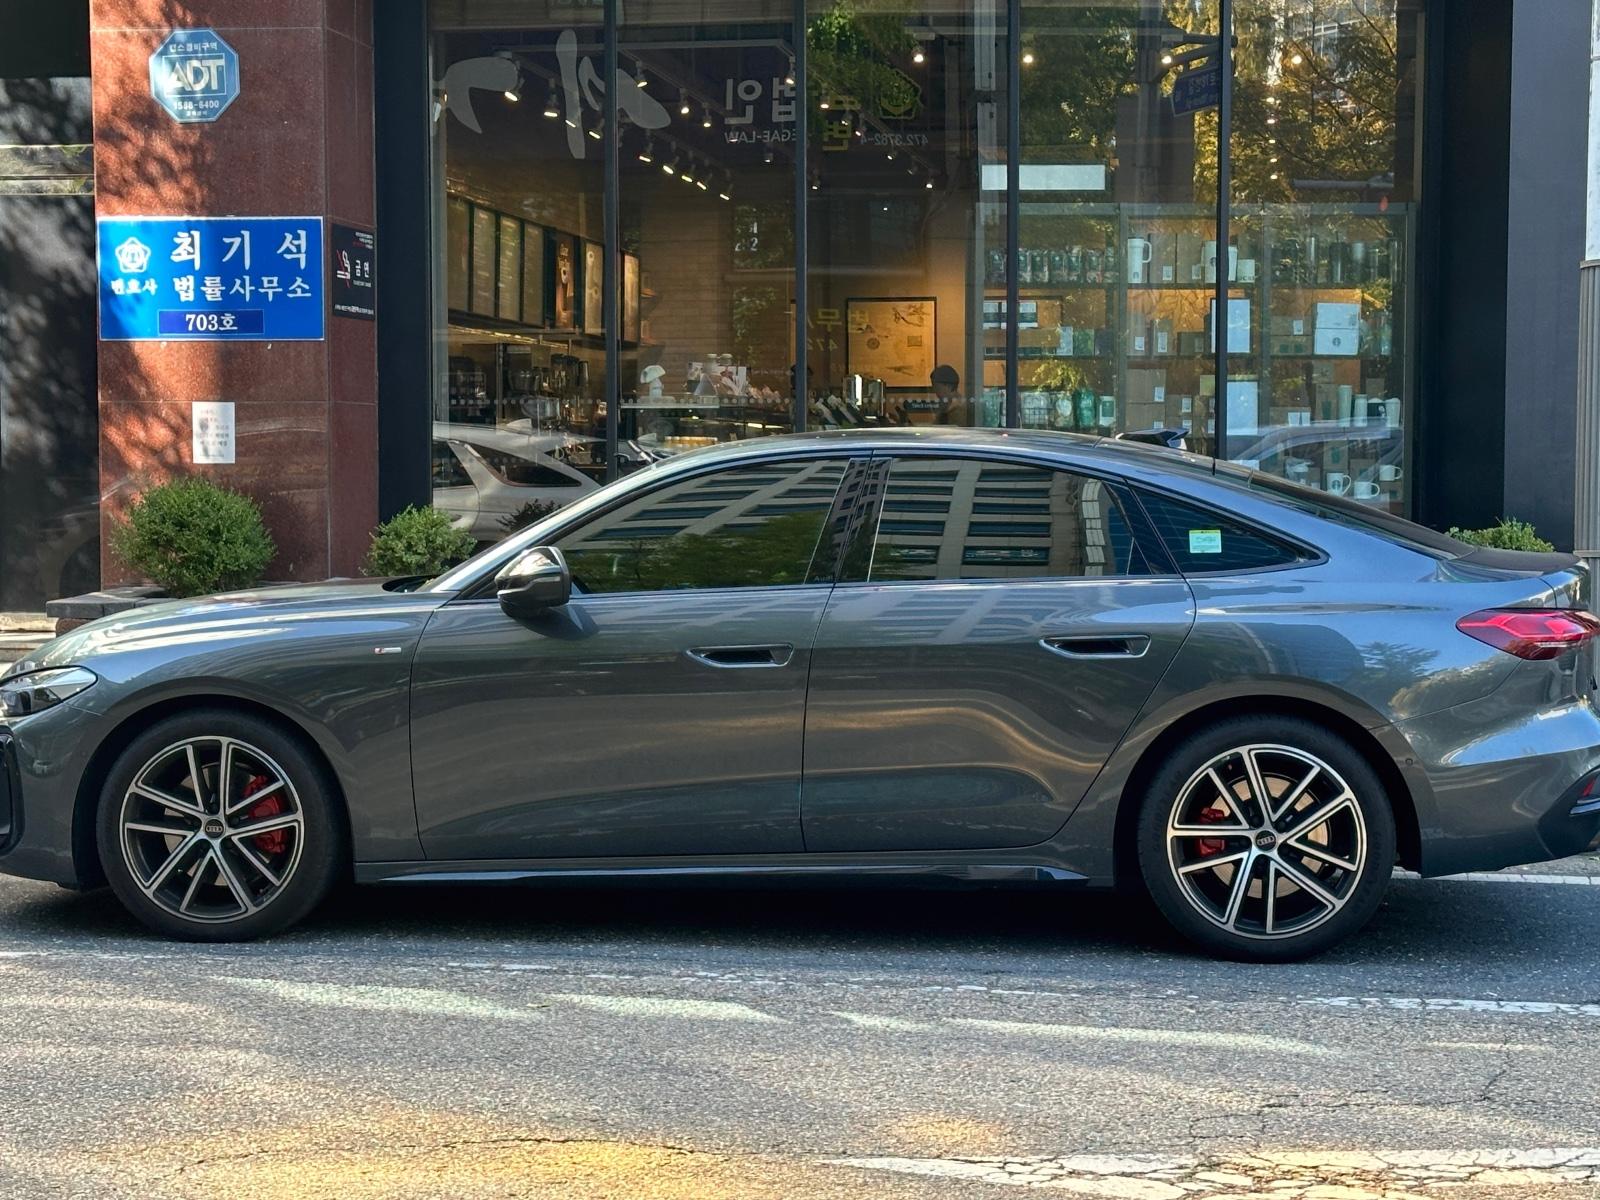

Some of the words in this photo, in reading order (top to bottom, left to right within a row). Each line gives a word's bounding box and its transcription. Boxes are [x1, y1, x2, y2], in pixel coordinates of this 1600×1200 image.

[166, 59, 225, 91] ADT
[174, 100, 219, 109] 1588-6400
[354, 259, 370, 278] 금연
[111, 278, 158, 296] 변호사
[172, 275, 313, 302] 법률사무소
[185, 313, 239, 332] 703호
